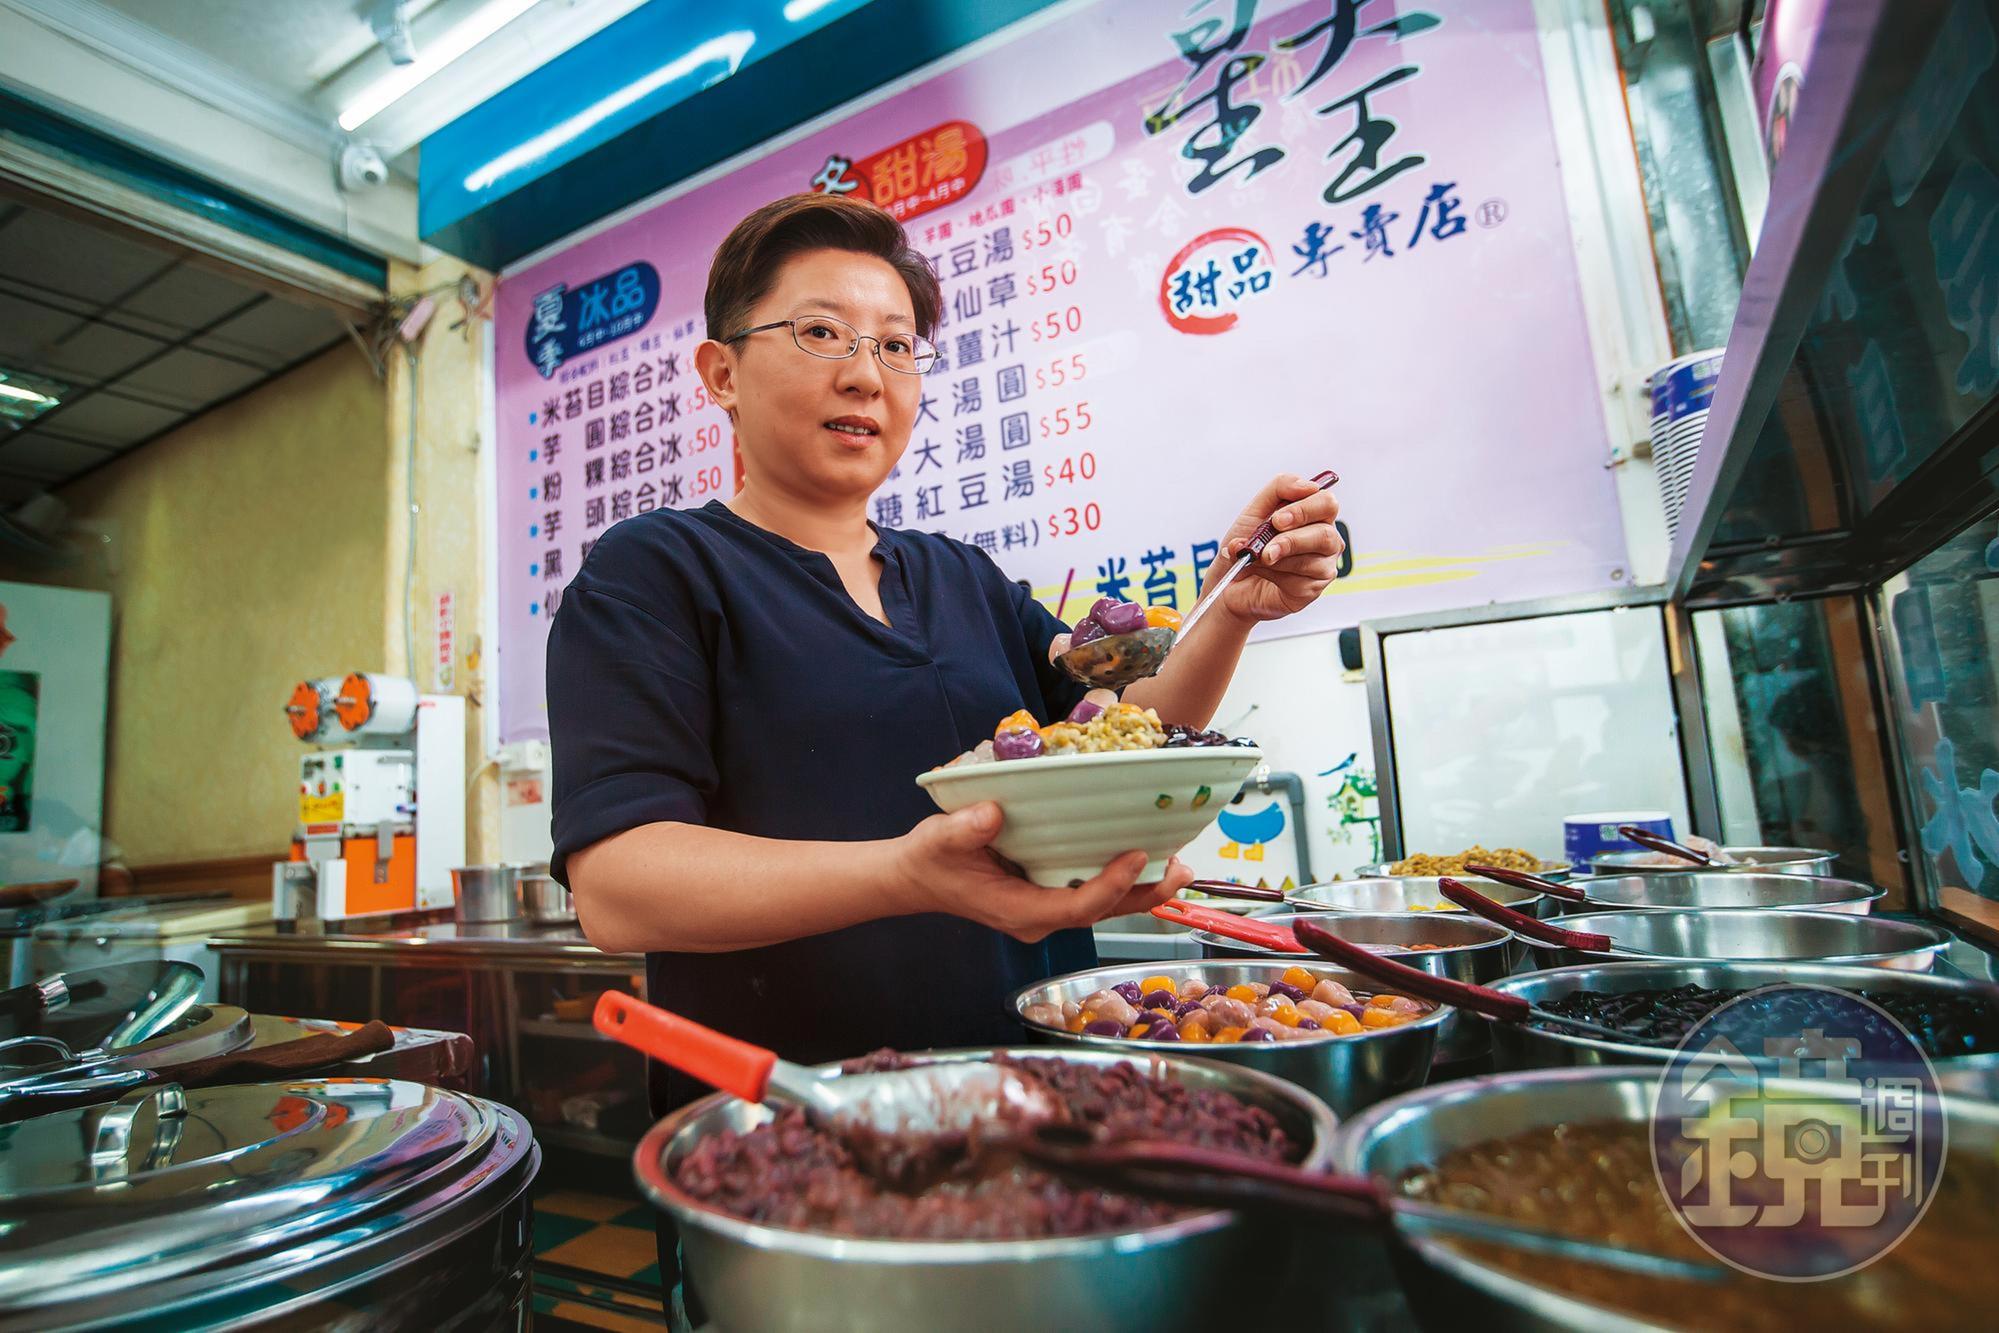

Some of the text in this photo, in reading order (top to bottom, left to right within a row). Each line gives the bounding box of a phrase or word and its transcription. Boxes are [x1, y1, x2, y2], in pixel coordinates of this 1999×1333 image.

[873, 126, 971, 205] 甜湯
[1023, 213, 1073, 251] $50
[1169, 248, 1273, 315] 甜品
[1290, 181, 1468, 279] 專賣店
[578, 267, 647, 331] 冰品
[940, 259, 1078, 327] 仙草 $50
[531, 284, 568, 380] 夏季
[1032, 307, 1082, 342] $50
[541, 353, 681, 428] 米苔目綜合冰
[1036, 353, 1087, 391] $55
[1040, 401, 1093, 439] $55
[687, 424, 722, 457] $50
[689, 465, 722, 499] $50
[1043, 452, 1097, 488] $40
[1048, 503, 1102, 539] $30
